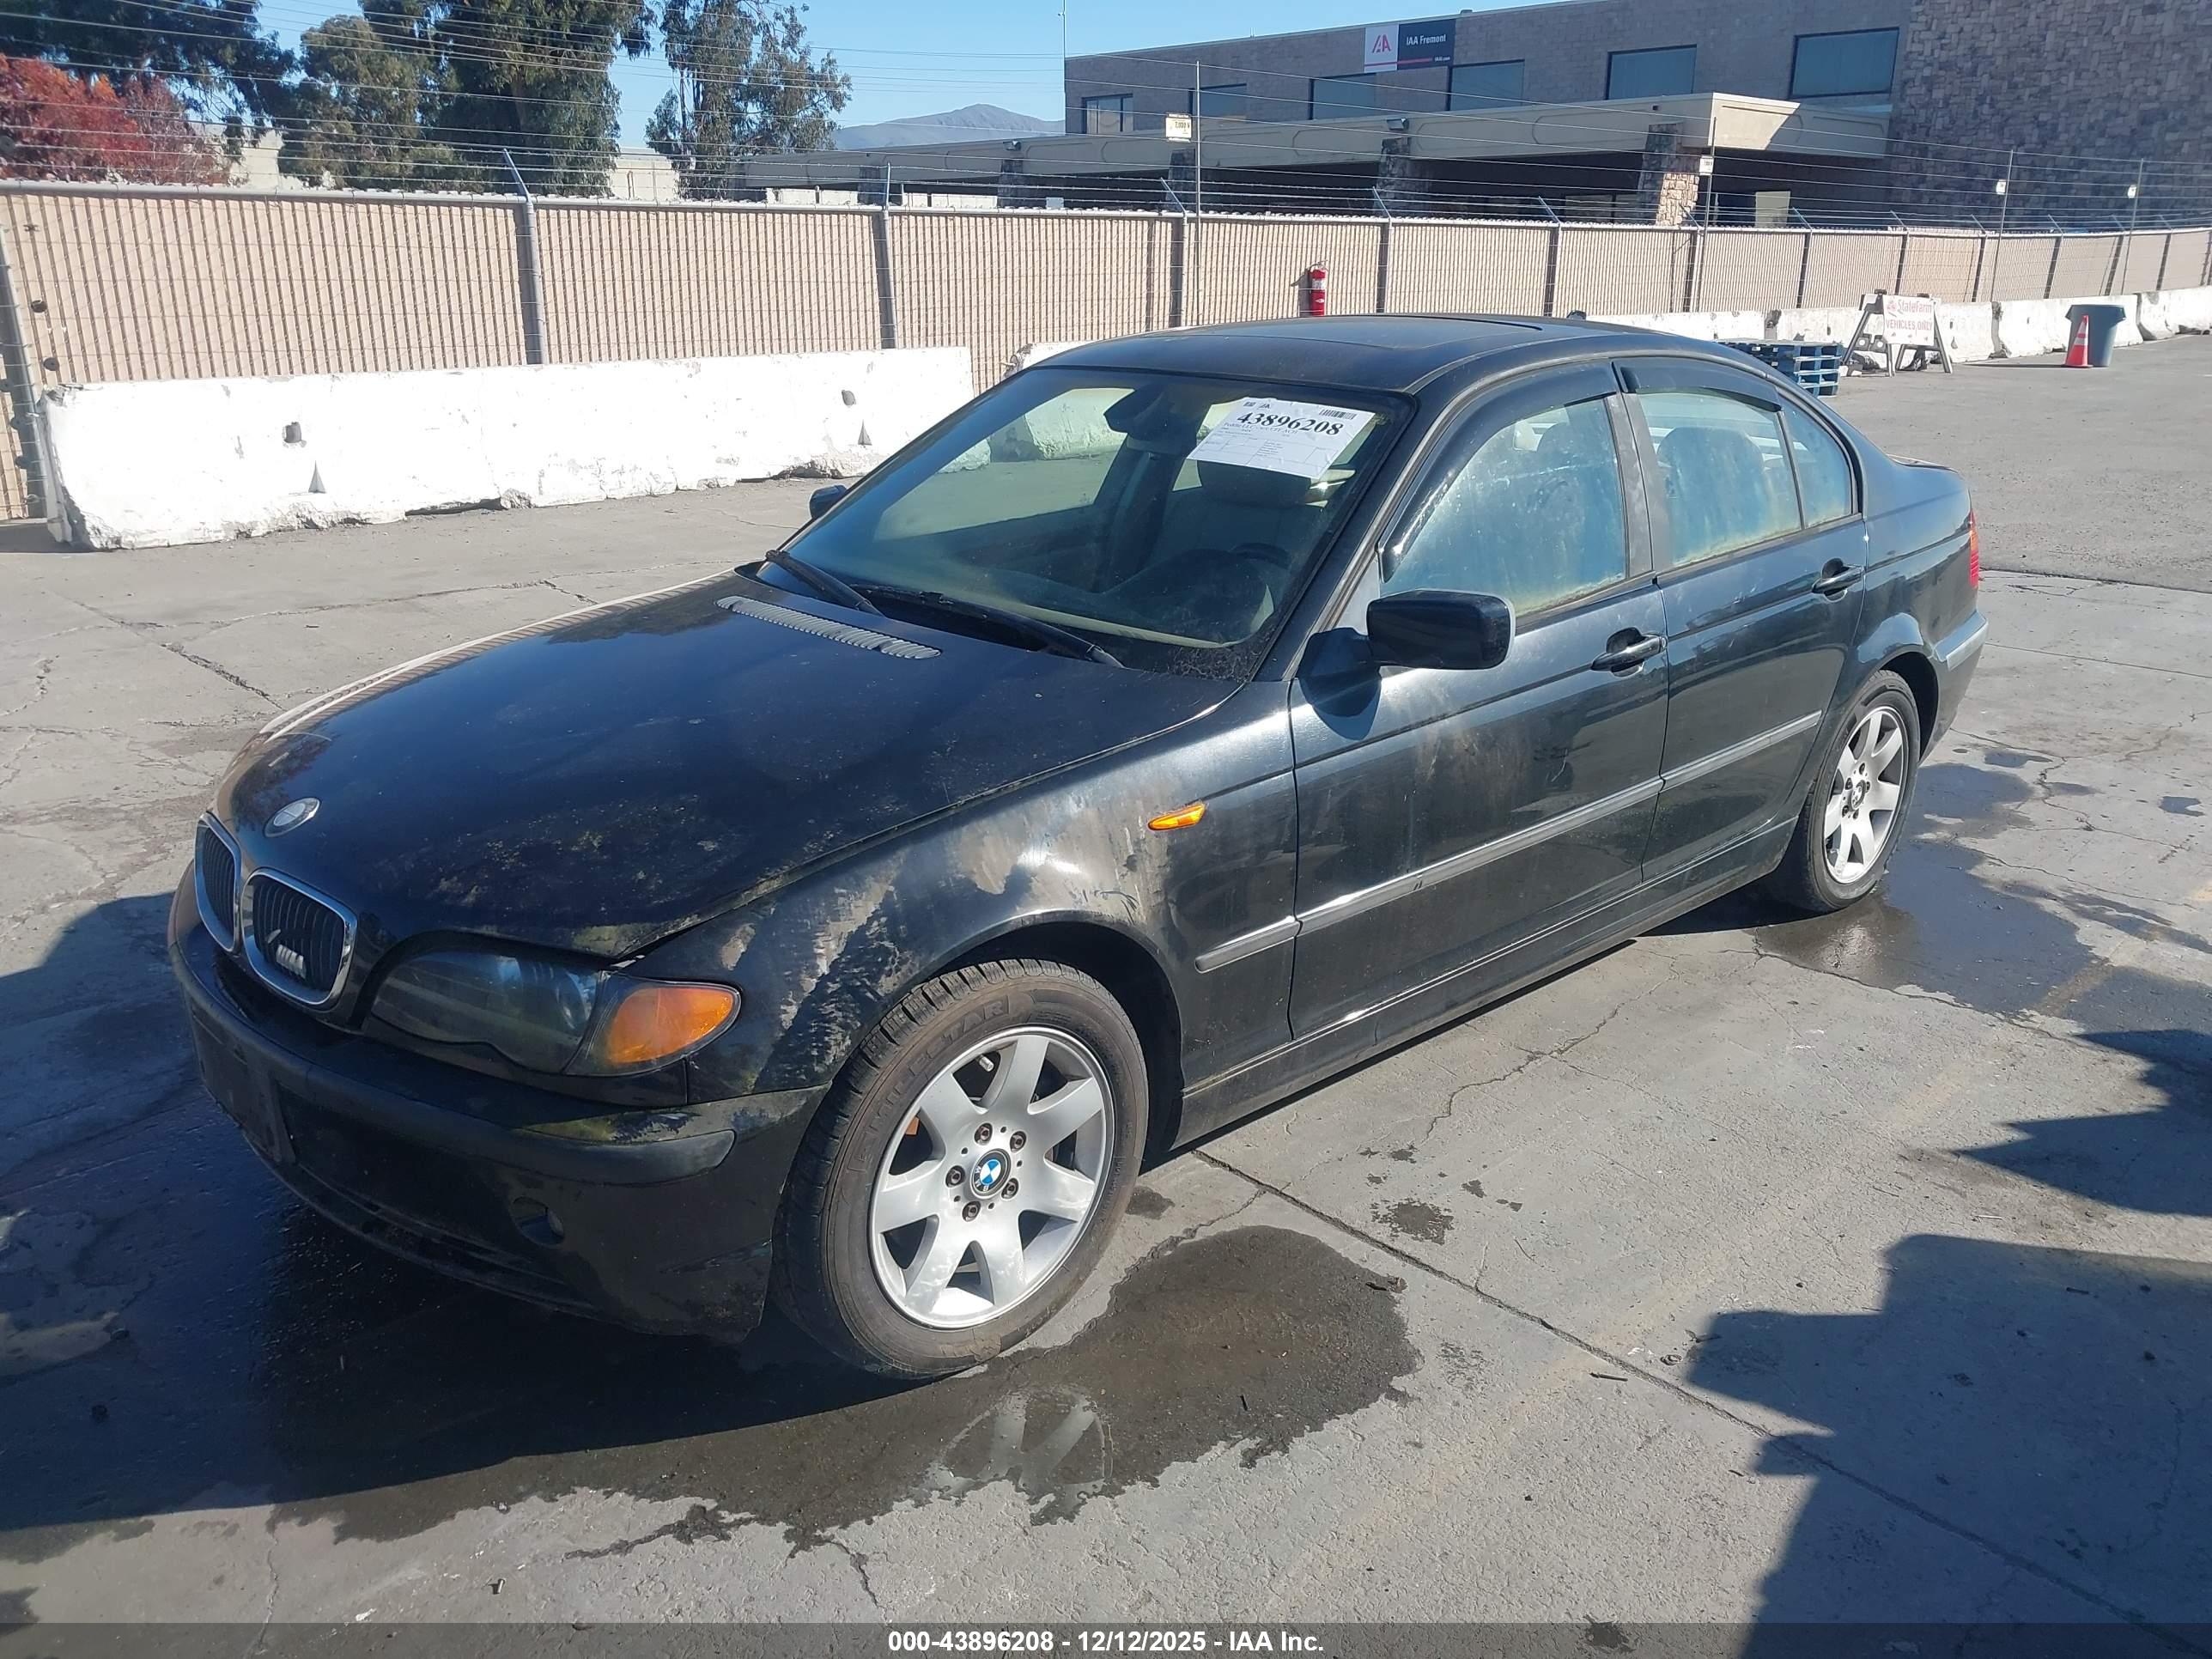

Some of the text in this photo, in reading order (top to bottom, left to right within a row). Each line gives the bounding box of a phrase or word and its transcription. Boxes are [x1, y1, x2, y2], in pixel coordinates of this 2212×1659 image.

[1406, 34, 1446, 46] IAA Fremont
[1886, 319, 1933, 331] VEHICLES ONLY
[1237, 412, 1344, 435] 43896208
